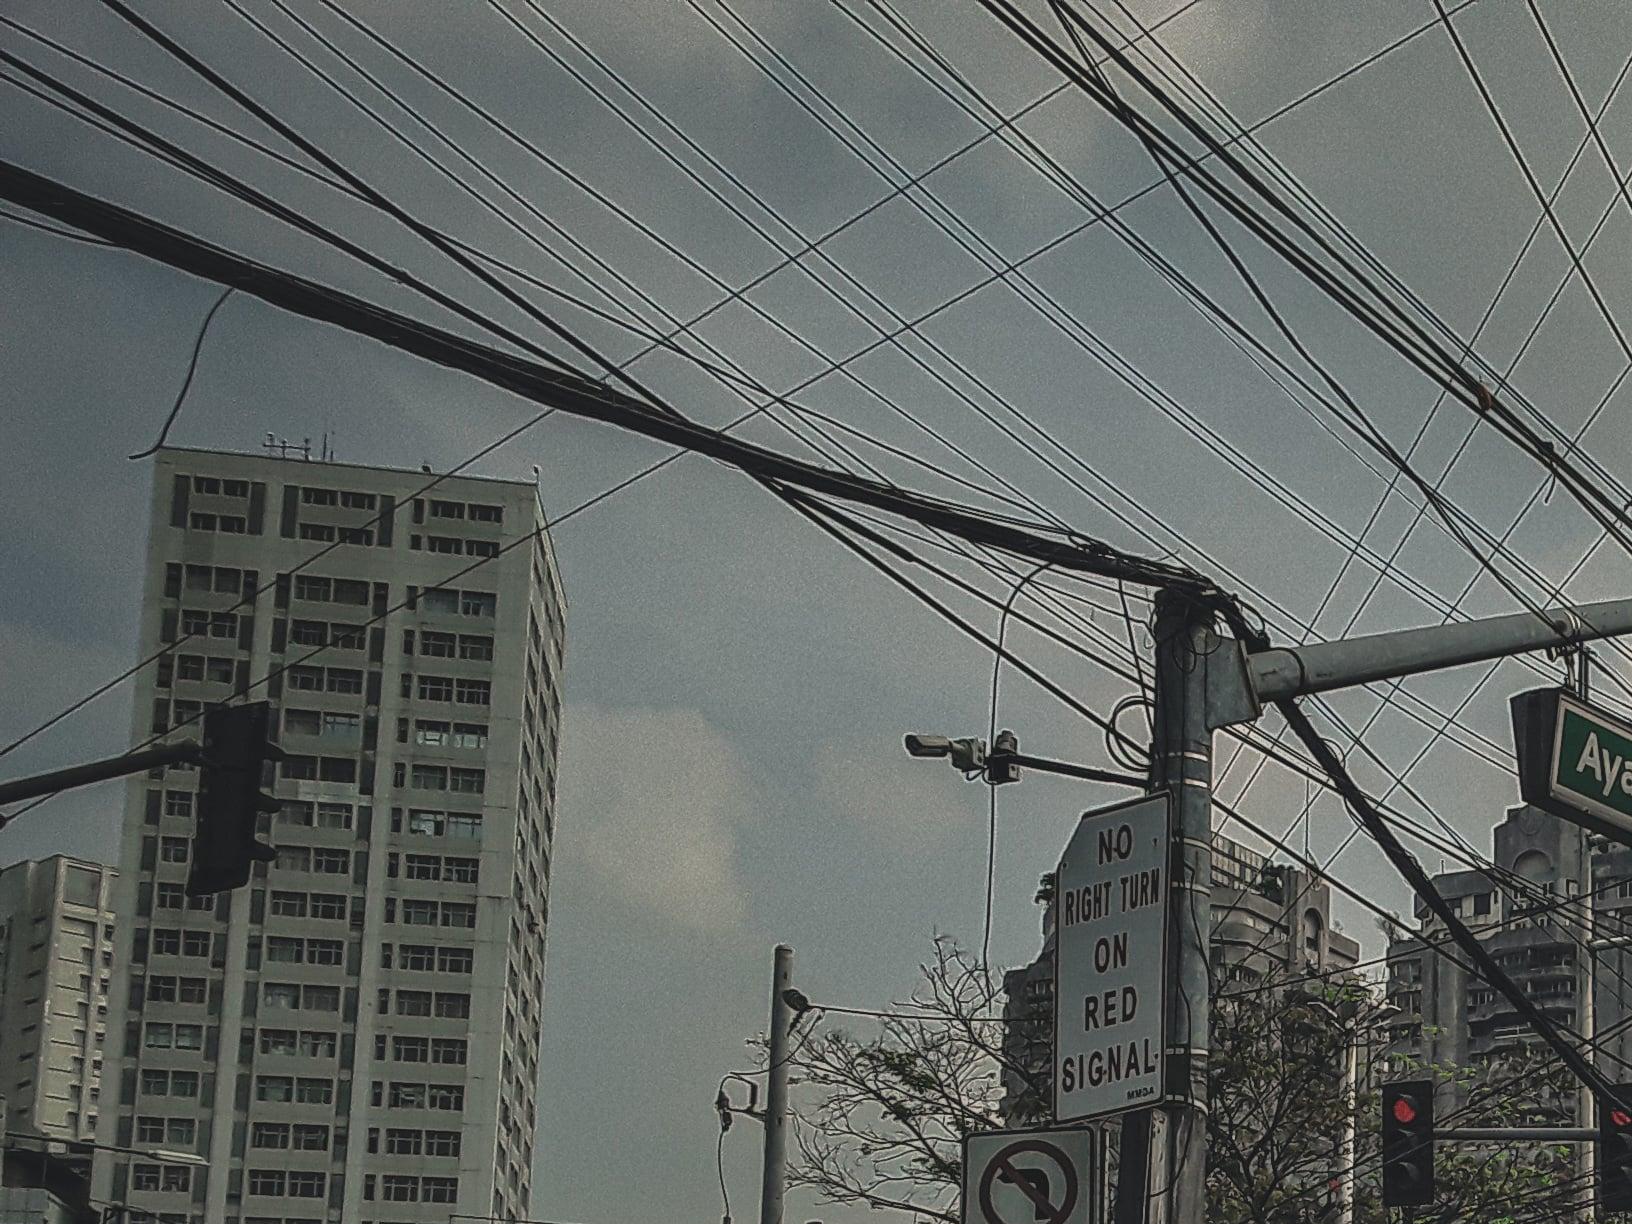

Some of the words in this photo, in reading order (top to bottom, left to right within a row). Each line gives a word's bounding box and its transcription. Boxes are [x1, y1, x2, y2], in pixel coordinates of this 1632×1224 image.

[1098, 824, 1133, 865] NO
[1065, 881, 1112, 926] RIGHT
[1120, 868, 1160, 913] TURN
[1094, 932, 1128, 973] ON
[1084, 986, 1137, 1031] RED
[1062, 1038, 1156, 1093] SIGNAL
